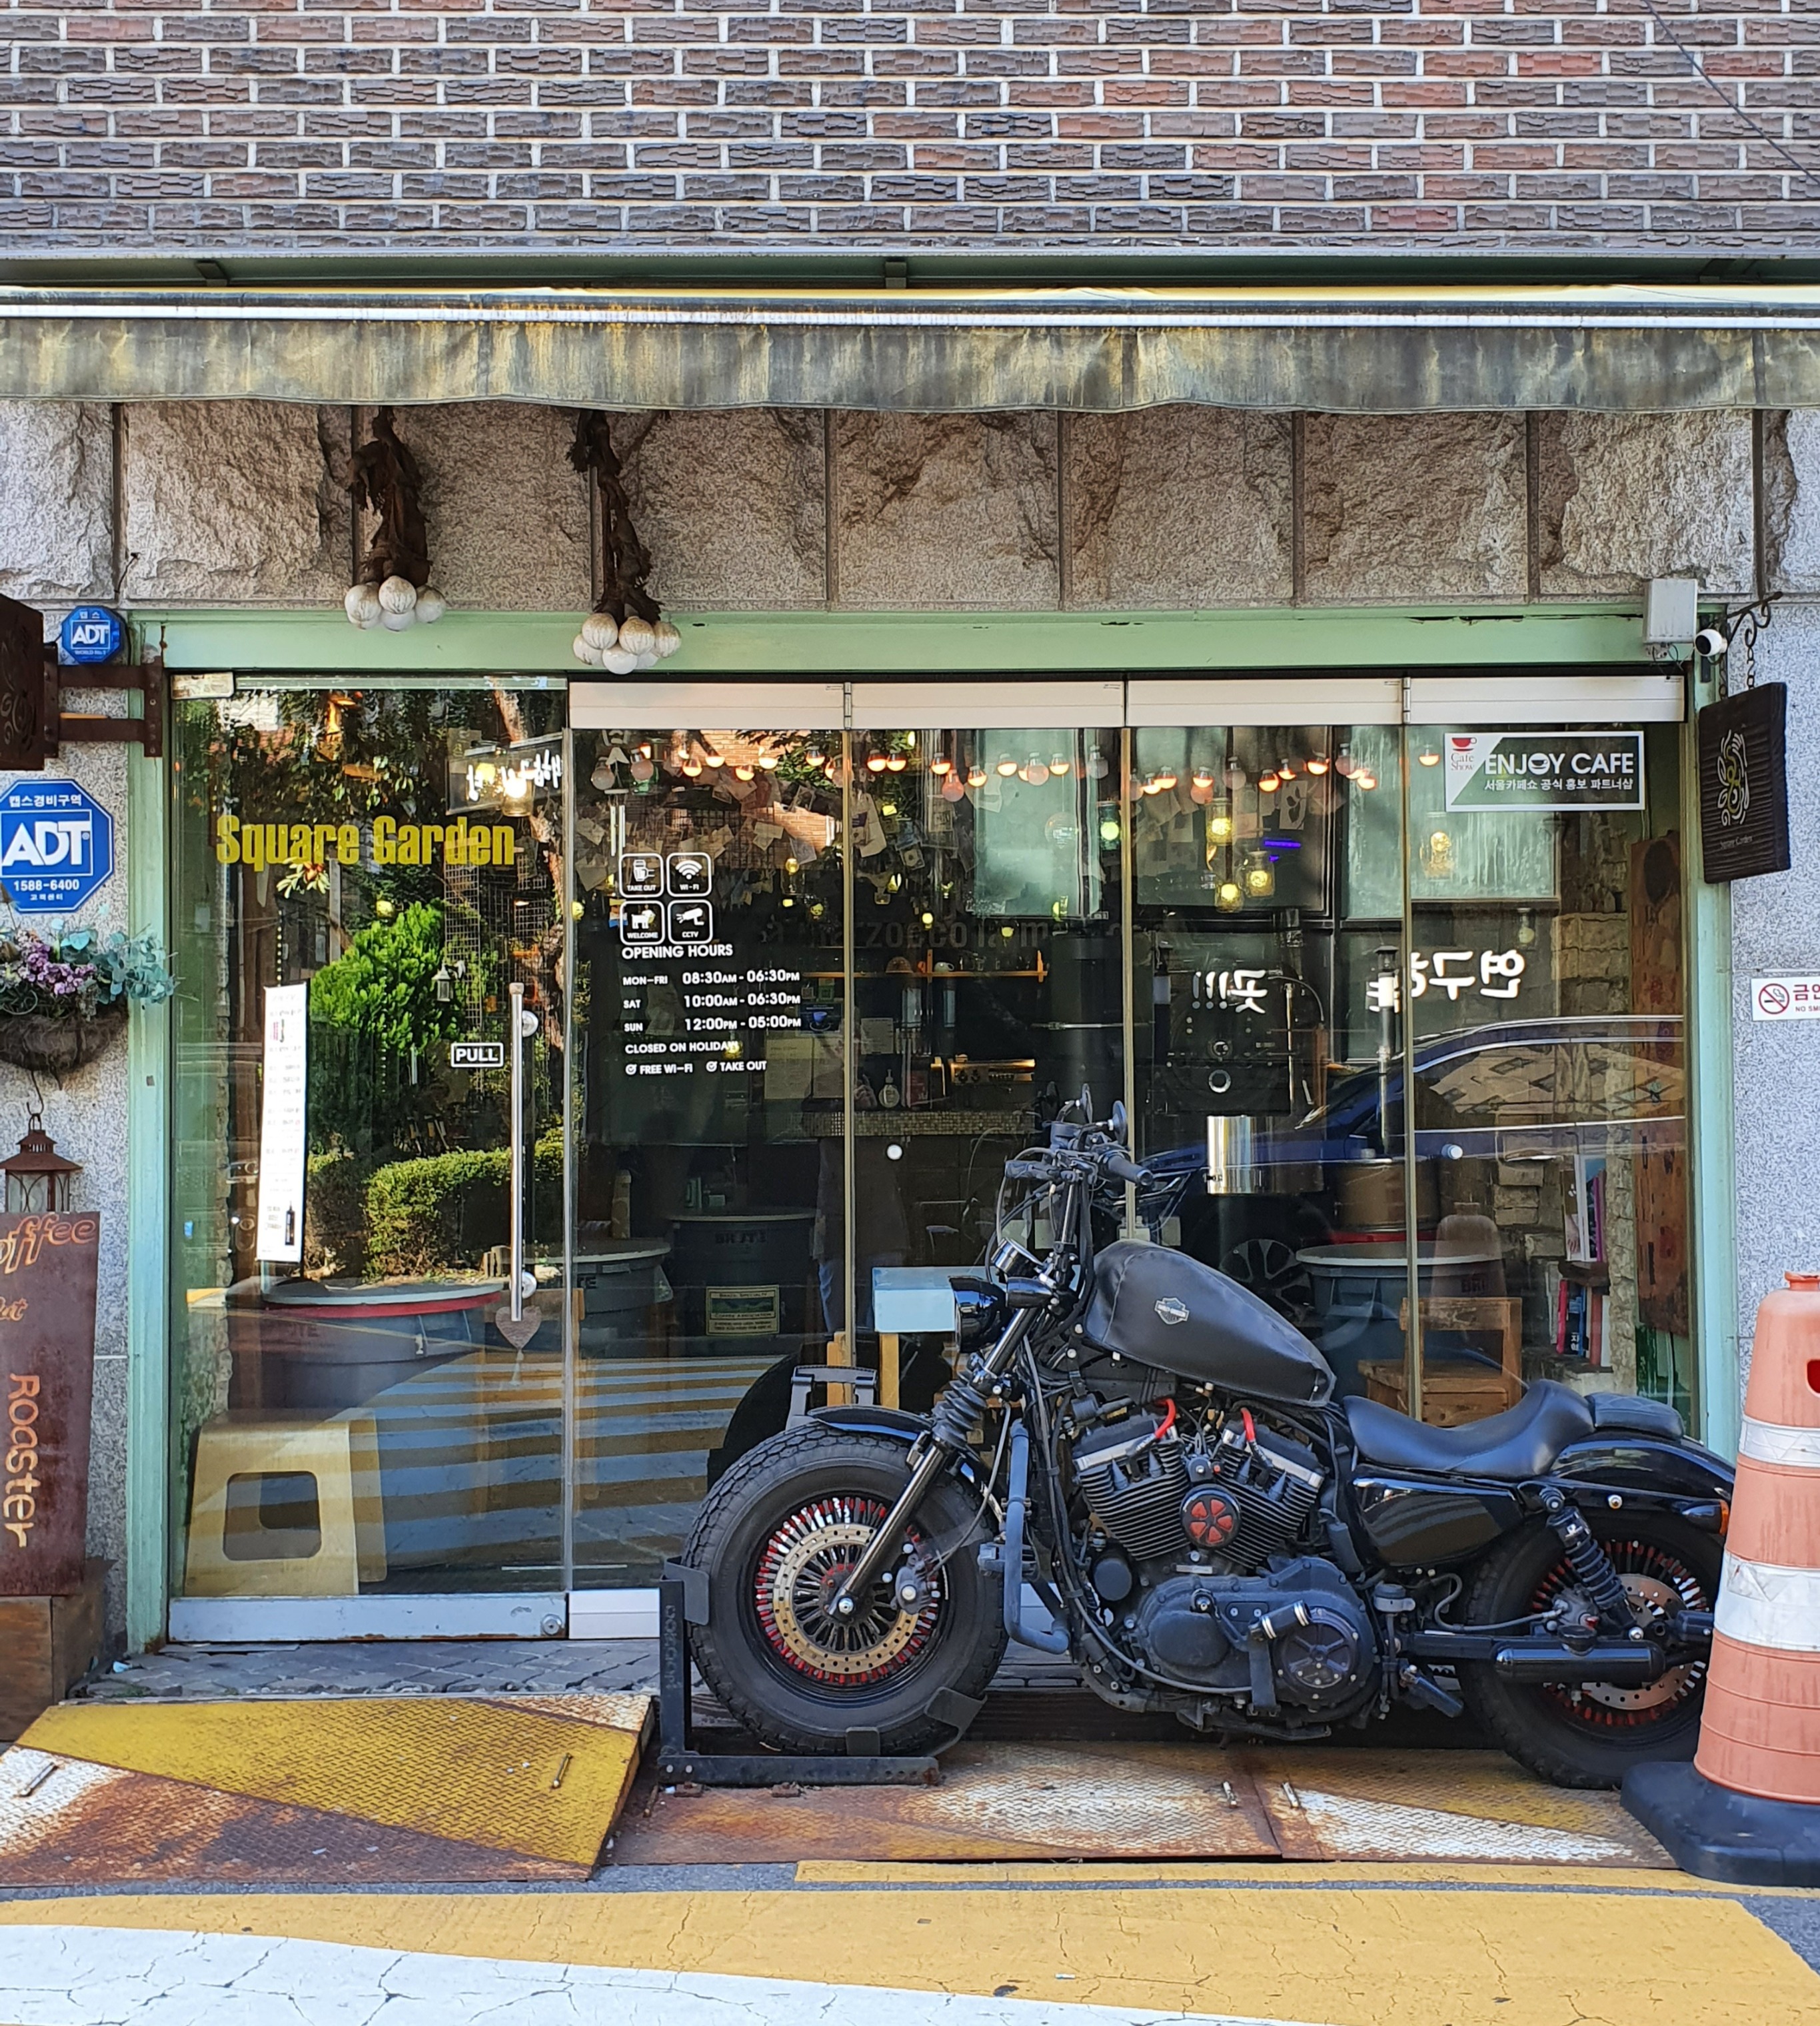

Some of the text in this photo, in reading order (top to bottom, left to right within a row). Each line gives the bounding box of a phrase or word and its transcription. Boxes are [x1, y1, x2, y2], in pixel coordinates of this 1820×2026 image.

[72, 624, 109, 645] ADT
[1484, 753, 1634, 775] ENJOY CAFE
[1484, 778, 1634, 791] 서울카페쇼 공식 홍보 파트너샵
[9, 794, 82, 808] 캡스경비구역
[2, 820, 92, 866] ADT
[217, 814, 514, 872] Square Garden
[13, 879, 80, 892] 1588-6400
[622, 944, 733, 960] OPENING HOURS
[622, 975, 668, 986] MON-FRI
[682, 971, 736, 985] 08:30AM
[746, 969, 800, 983] 06:30PM
[623, 1000, 641, 1009] SAT
[684, 994, 738, 1008] 10:00AM
[747, 992, 800, 1006] 06:30PM
[624, 1022, 643, 1032] SUN
[685, 1017, 738, 1031] 12:00PM
[748, 1015, 802, 1029] 05:00PM
[455, 1048, 498, 1062] PULL
[625, 1044, 666, 1054] CLOSED
[669, 1042, 686, 1052] ON
[640, 1065, 662, 1074] FREE
[720, 1062, 744, 1072] TAKE
[746, 1060, 767, 1070] OUT
[3, 1374, 40, 1547] Roaster
